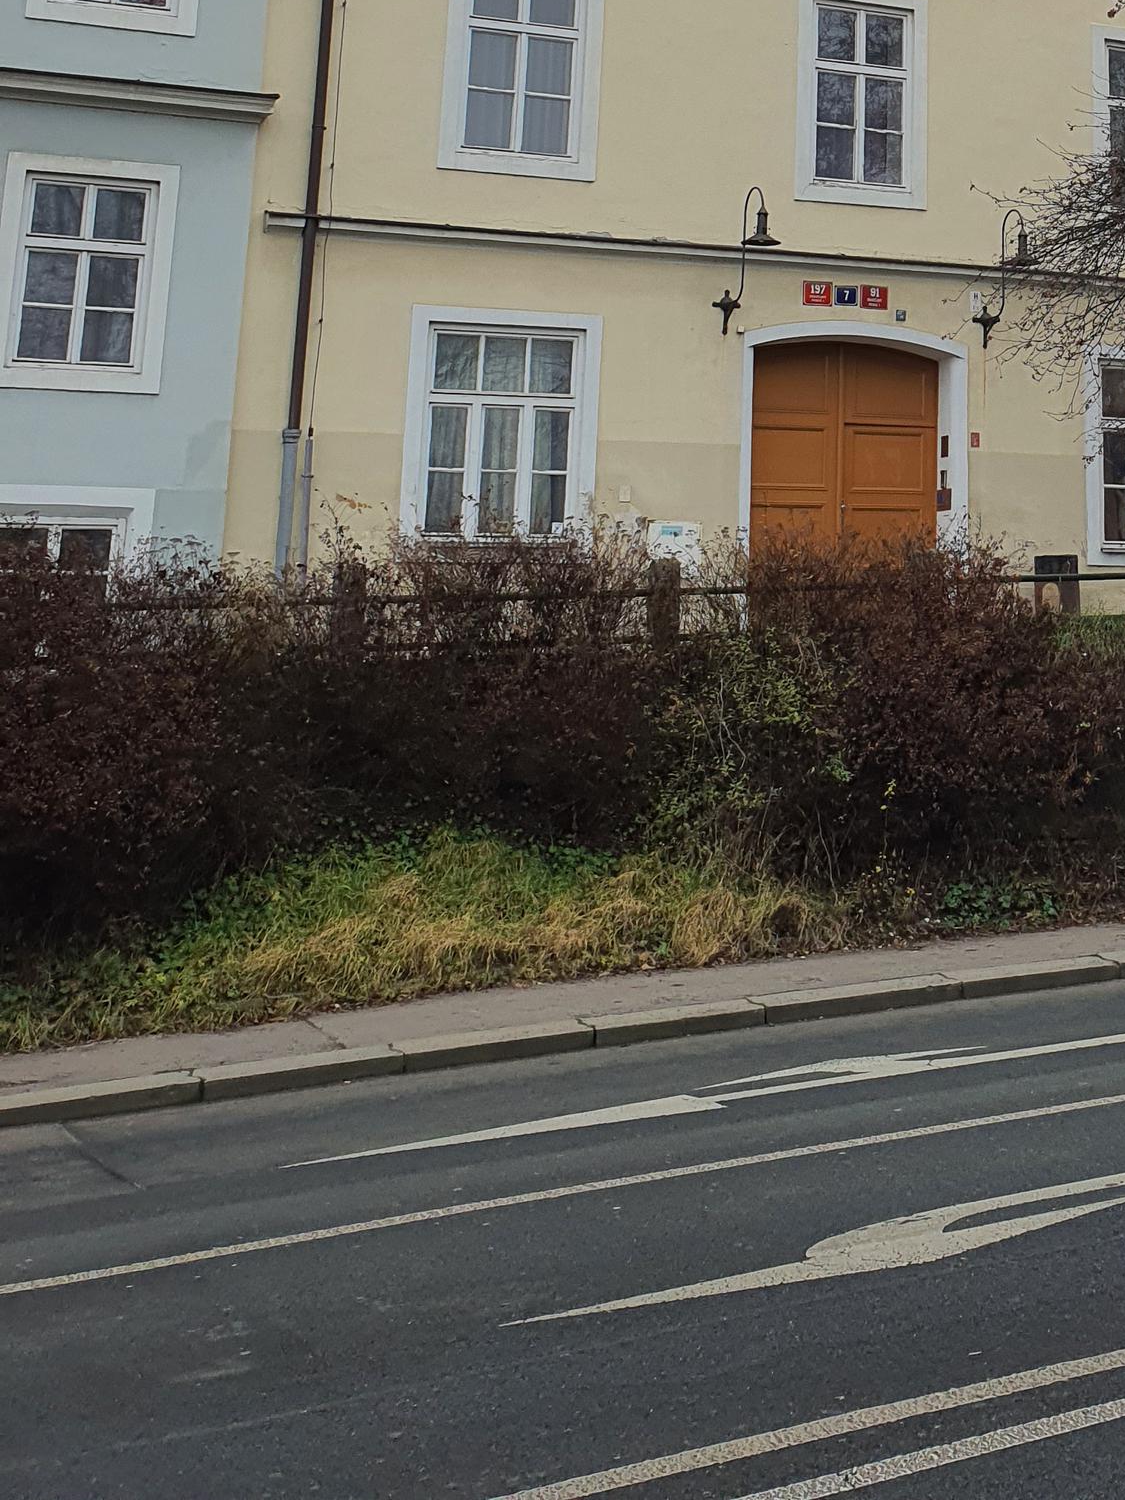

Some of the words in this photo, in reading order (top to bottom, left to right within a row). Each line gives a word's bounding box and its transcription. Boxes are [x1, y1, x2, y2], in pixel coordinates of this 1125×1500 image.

[810, 284, 826, 295] 197
[870, 287, 880, 298] 91
[843, 290, 850, 301] 7
